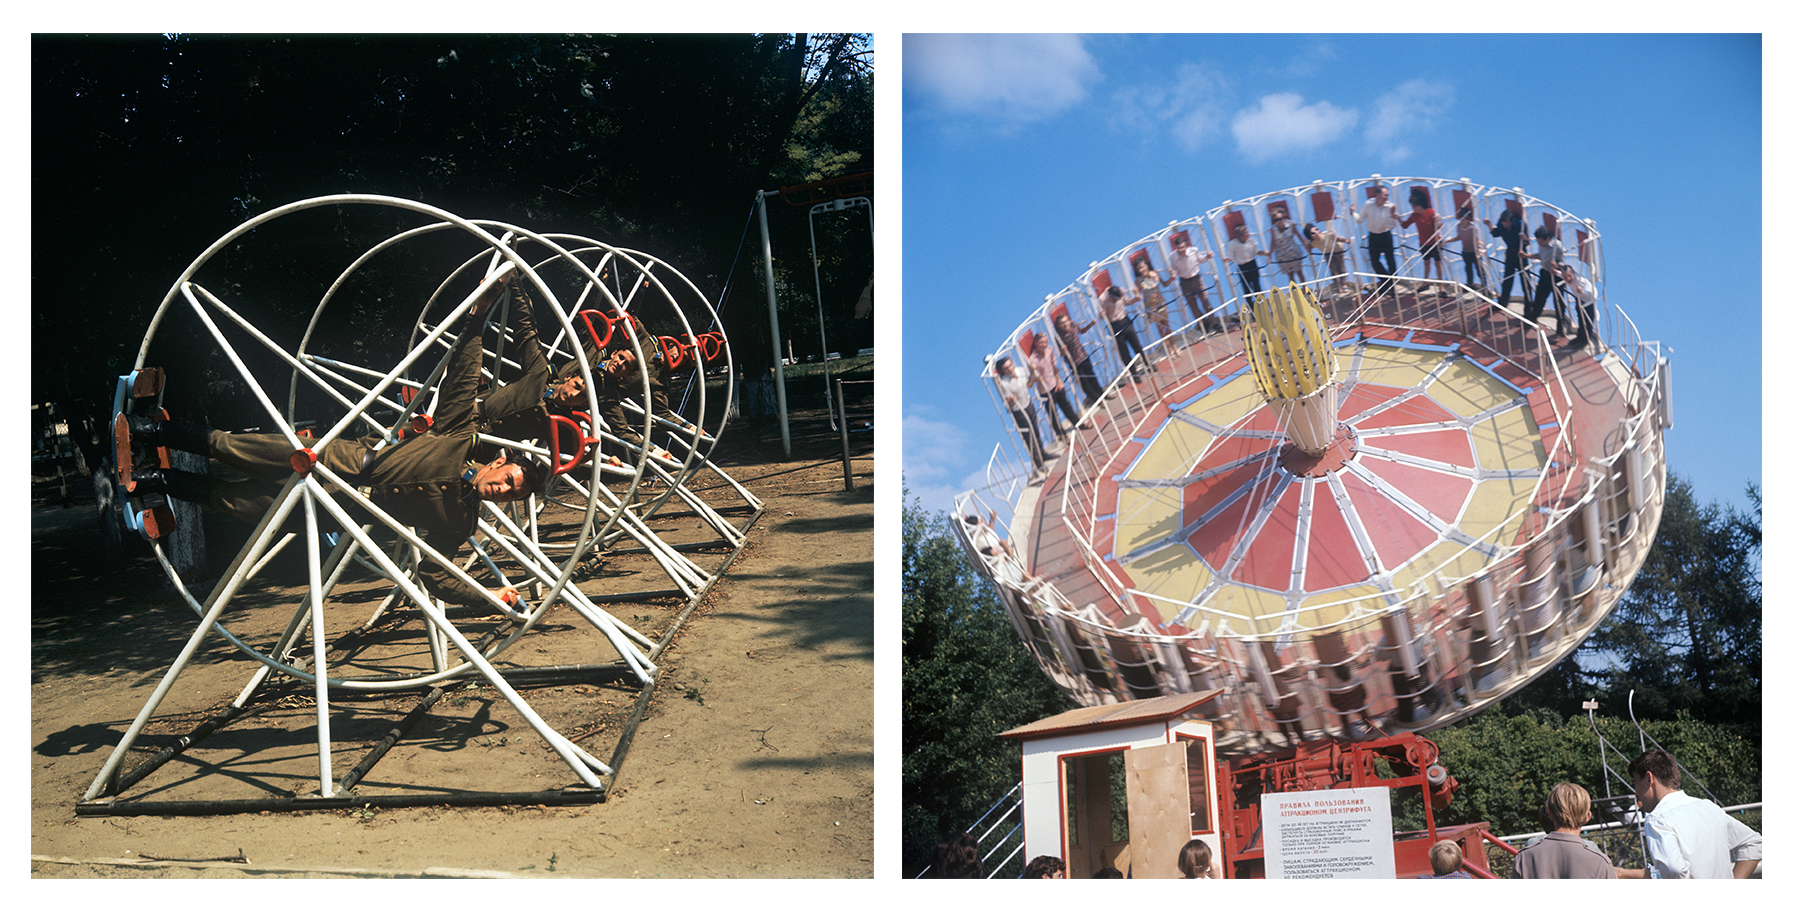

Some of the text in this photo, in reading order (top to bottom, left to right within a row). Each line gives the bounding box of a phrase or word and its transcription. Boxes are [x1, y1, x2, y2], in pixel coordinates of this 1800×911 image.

[1314, 799, 1364, 807] ПОЛЬЗОВАНИЯ
[1280, 806, 1372, 817] АТТРАКЦИОНОМ ЦЕНТРИФУГА
